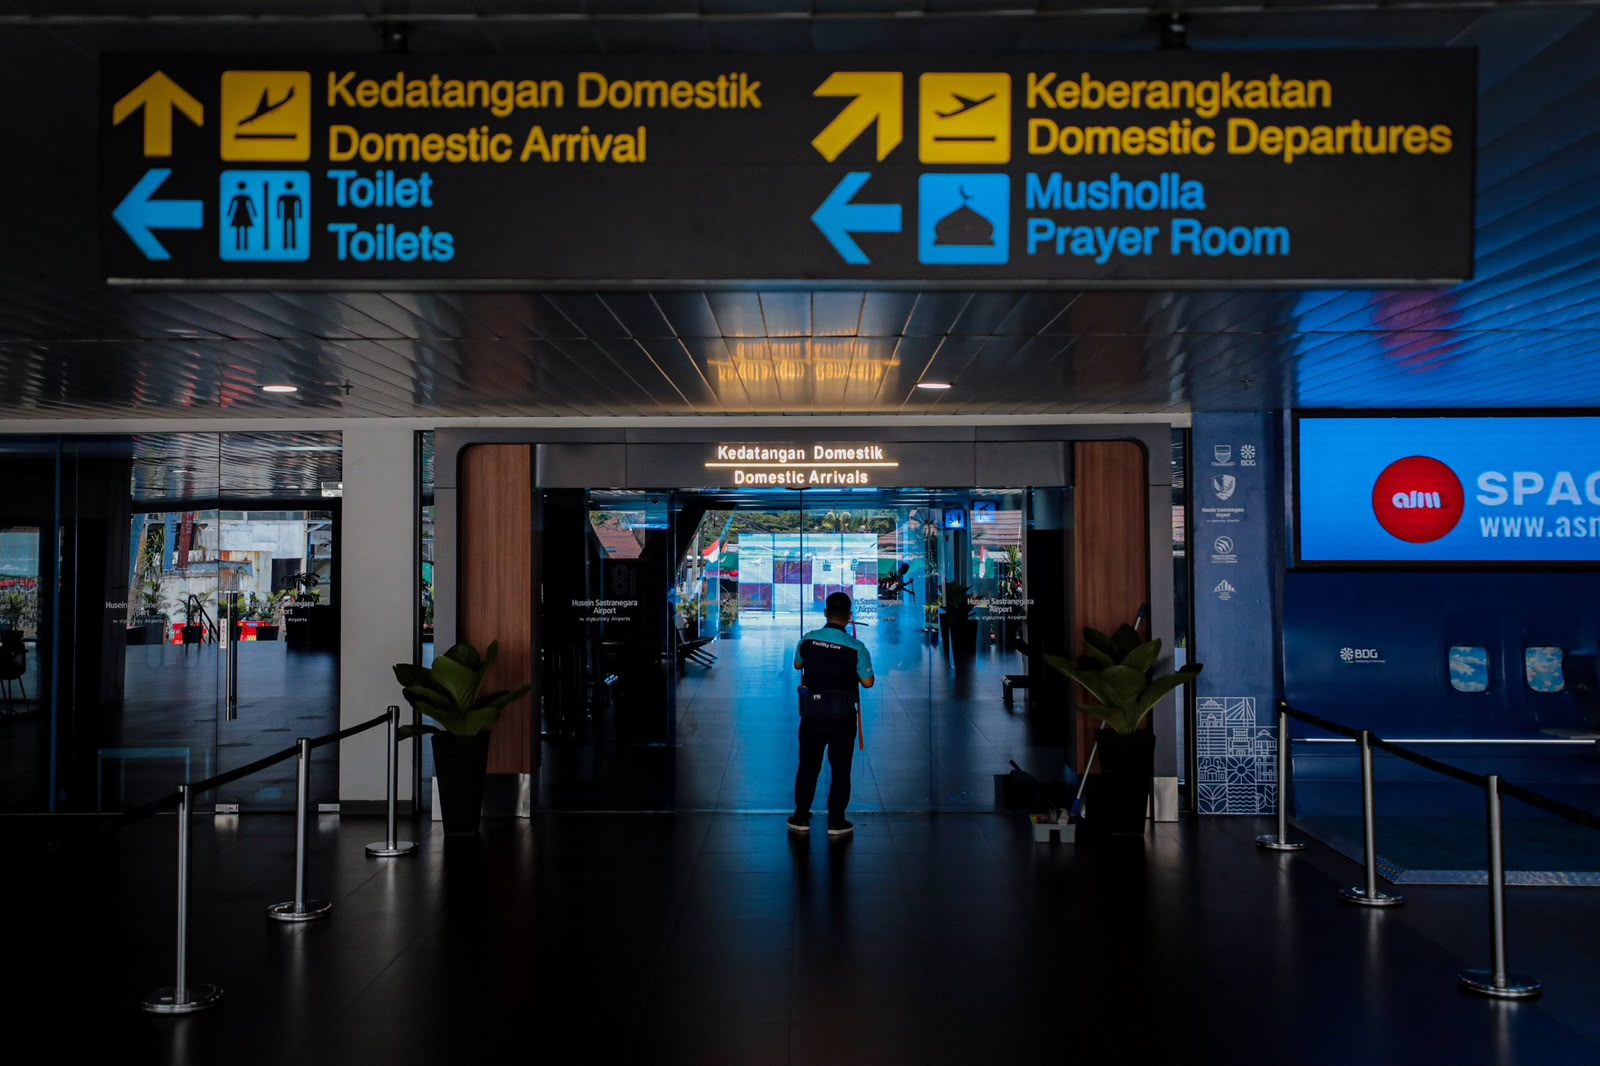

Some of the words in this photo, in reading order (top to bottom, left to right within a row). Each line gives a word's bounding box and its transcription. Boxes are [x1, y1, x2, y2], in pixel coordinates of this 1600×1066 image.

[328, 72, 563, 116] Kedatangan
[578, 72, 761, 108] Domestik
[1027, 72, 1332, 117] Keberangkatan
[330, 126, 511, 162] Domestic
[521, 126, 646, 162] Arrival
[1028, 118, 1215, 155] Domestic
[1228, 118, 1452, 163] Departures
[327, 170, 433, 208] Toilet
[1026, 172, 1206, 210] Musholla
[328, 224, 454, 261] Toilets
[1027, 218, 1160, 264] Prayer
[1171, 219, 1291, 256] Room
[718, 446, 805, 463] Kedatangan
[814, 445, 883, 460] Domestik
[735, 470, 805, 484] Domestic
[809, 470, 868, 484] Arrivals
[593, 607, 616, 615] Airport
[595, 599, 638, 608] Sastranegara
[989, 604, 1012, 613] Airport
[991, 598, 1034, 607] Sastranegara
[1355, 649, 1378, 659] BDG
